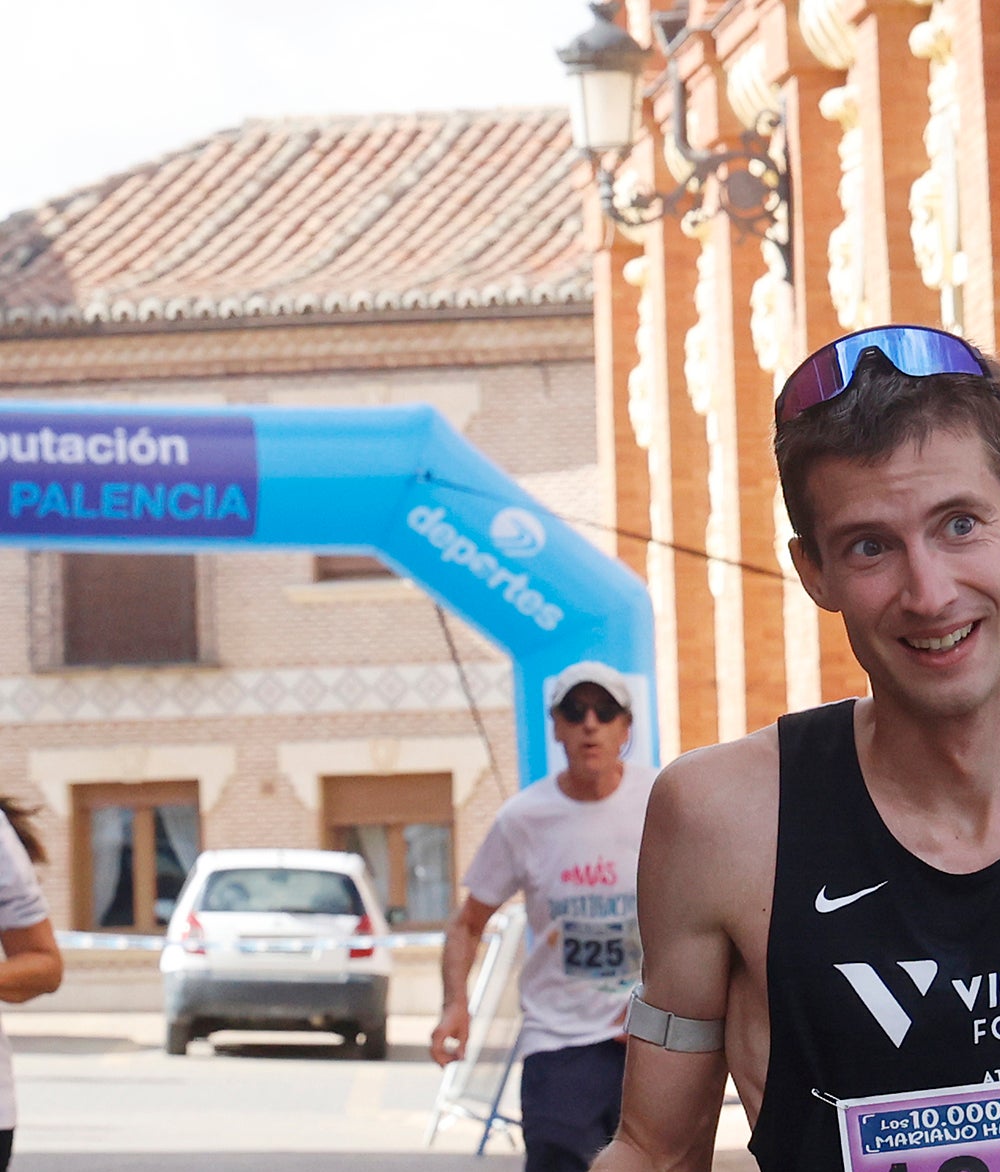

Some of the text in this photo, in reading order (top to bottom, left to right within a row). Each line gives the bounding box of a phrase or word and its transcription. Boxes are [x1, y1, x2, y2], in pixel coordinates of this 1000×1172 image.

[9, 481, 249, 519] PALENCIA
[407, 505, 565, 632] deportes
[564, 938, 625, 967] 225
[875, 1126, 978, 1149] MARIANO
